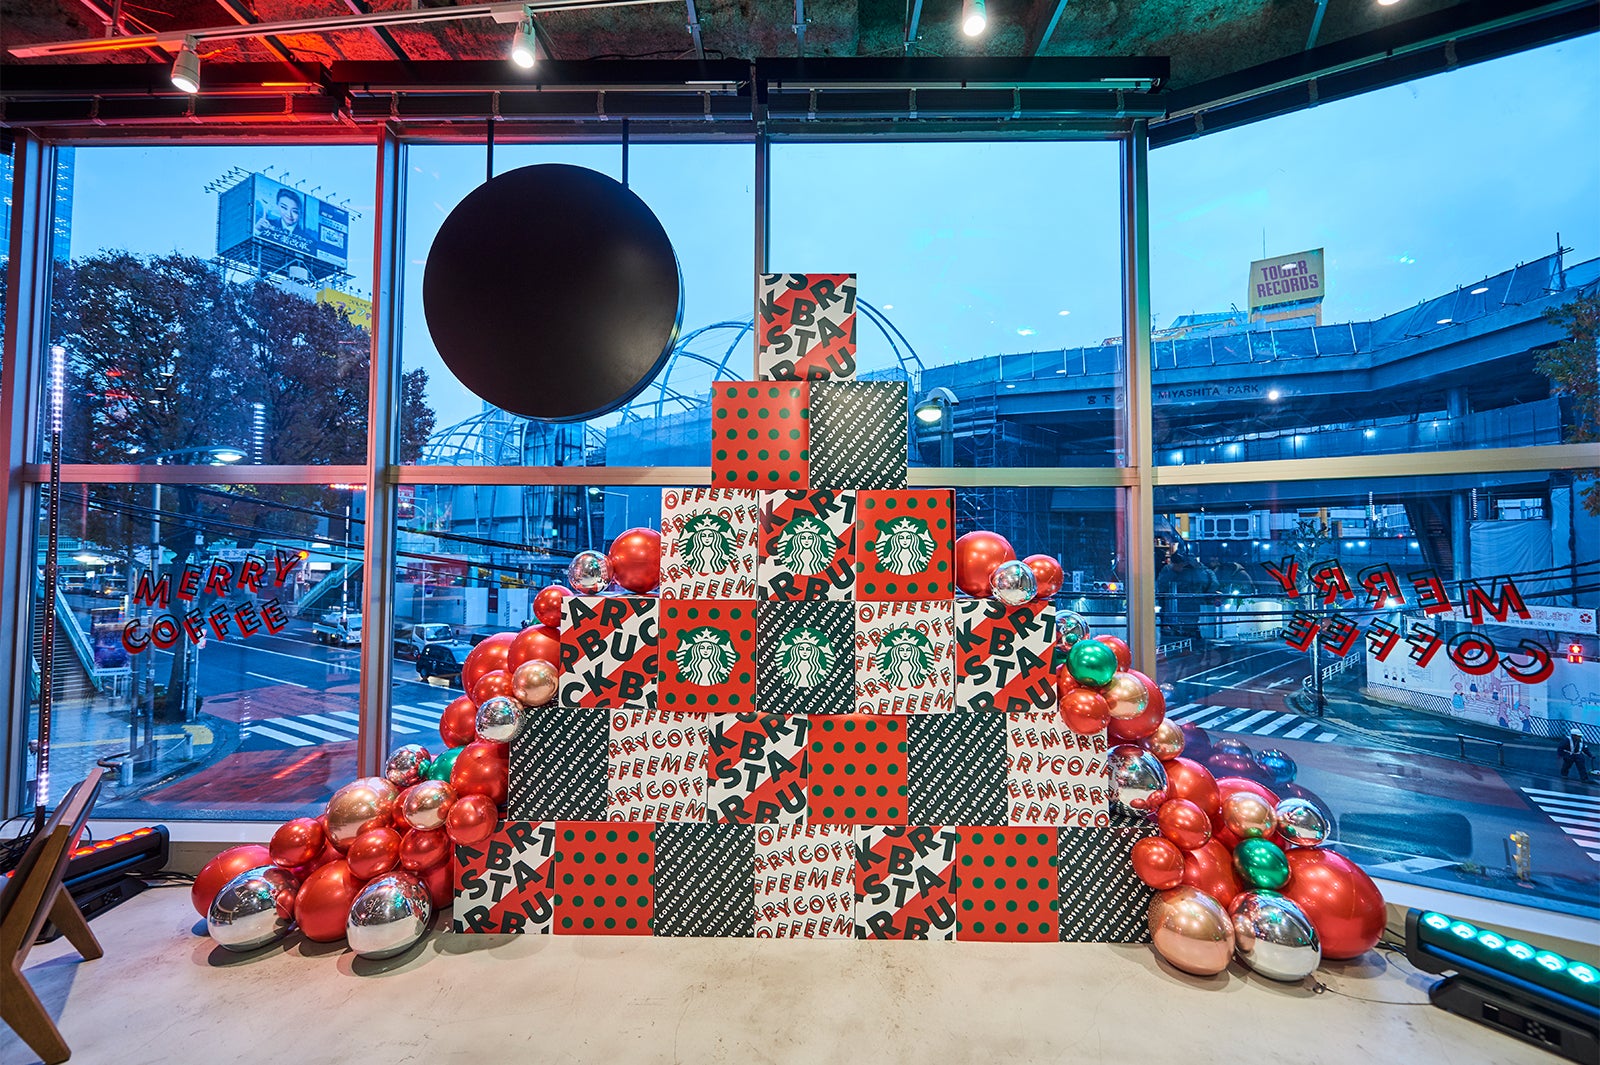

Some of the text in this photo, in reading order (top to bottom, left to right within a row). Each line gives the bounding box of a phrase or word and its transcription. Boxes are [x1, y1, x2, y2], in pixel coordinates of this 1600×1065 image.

[1256, 273, 1319, 298] RECORDS
[1261, 259, 1308, 281] TOWER
[824, 403, 844, 426] MERRY
[843, 381, 863, 403] COFFEE
[1158, 384, 1259, 399] MIYASHITA PARK
[825, 418, 845, 442] COFFEE
[844, 396, 863, 418] MERRY
[827, 388, 884, 456] MERRY COFFEE MERRY
[827, 381, 904, 472] COFFEE MERRY COFFEE MERRY
[830, 395, 908, 486] MERRY COFFEE MERRY COFFEE
[849, 411, 908, 478] MERRY COFFEE MERRY
[133, 550, 301, 608] MERRY
[121, 598, 289, 655] COFFEE
[756, 610, 776, 632] COFFEE
[766, 615, 785, 637] MERRY
[820, 602, 839, 625] MERRY
[762, 688, 780, 710] MERRY
[804, 664, 844, 710] COFFEE MERRY
[834, 668, 853, 692] MERRY
[523, 725, 563, 771] COFFEE MERRY
[524, 708, 564, 755] MERRY COFFEE
[526, 763, 545, 786] MERRY
[545, 739, 566, 762] COFFEE
[565, 717, 585, 739] MERRY
[526, 779, 546, 802] COFFEE
[546, 756, 565, 779] MERRY
[565, 732, 586, 756] COFFEE
[585, 709, 605, 732] MERRY
[922, 737, 941, 760] MERRY
[941, 713, 961, 737] COFFEE
[923, 753, 943, 777] COFFEE
[942, 729, 961, 753] MERRY
[925, 768, 945, 791] MERRY
[944, 745, 965, 768] COFFEE
[964, 721, 983, 744] MERRY
[528, 794, 547, 816] MERRY
[547, 771, 568, 794] COFFEE
[567, 747, 587, 770] MERRY
[587, 724, 608, 747] COFFEE
[548, 740, 610, 810] MERRY COFFEE MERRY
[926, 713, 1003, 808] COFFEE MERRY COFFEE MERRY
[928, 728, 1008, 823] MERRY COFFEE MERRY COFFEE
[949, 744, 1009, 816] MERRY COFFEE MERRY
[656, 840, 696, 886] COFFEE MERRY
[657, 833, 715, 902] MERRY COFFEE MERRY
[658, 824, 738, 918] COFFEE MERRY COFFEE MERRY
[659, 840, 739, 934] MERRY COFFEE MERRY COFFEE
[1060, 844, 1100, 892] COFFEE MERRY
[1062, 837, 1120, 908] MERRY COFFEE MERRY
[1064, 828, 1143, 924] COFFEE MERRY COFFEE MERRY
[681, 856, 740, 926] MERRY COFFEE MERRY
[701, 871, 741, 919] MERRY COFFEE
[1065, 869, 1124, 940] MERRY COFFEE MERRY
[1088, 884, 1128, 932] MERRY COFFEE
[1108, 901, 1127, 924] MERRY
[703, 911, 724, 934] COFFEE
